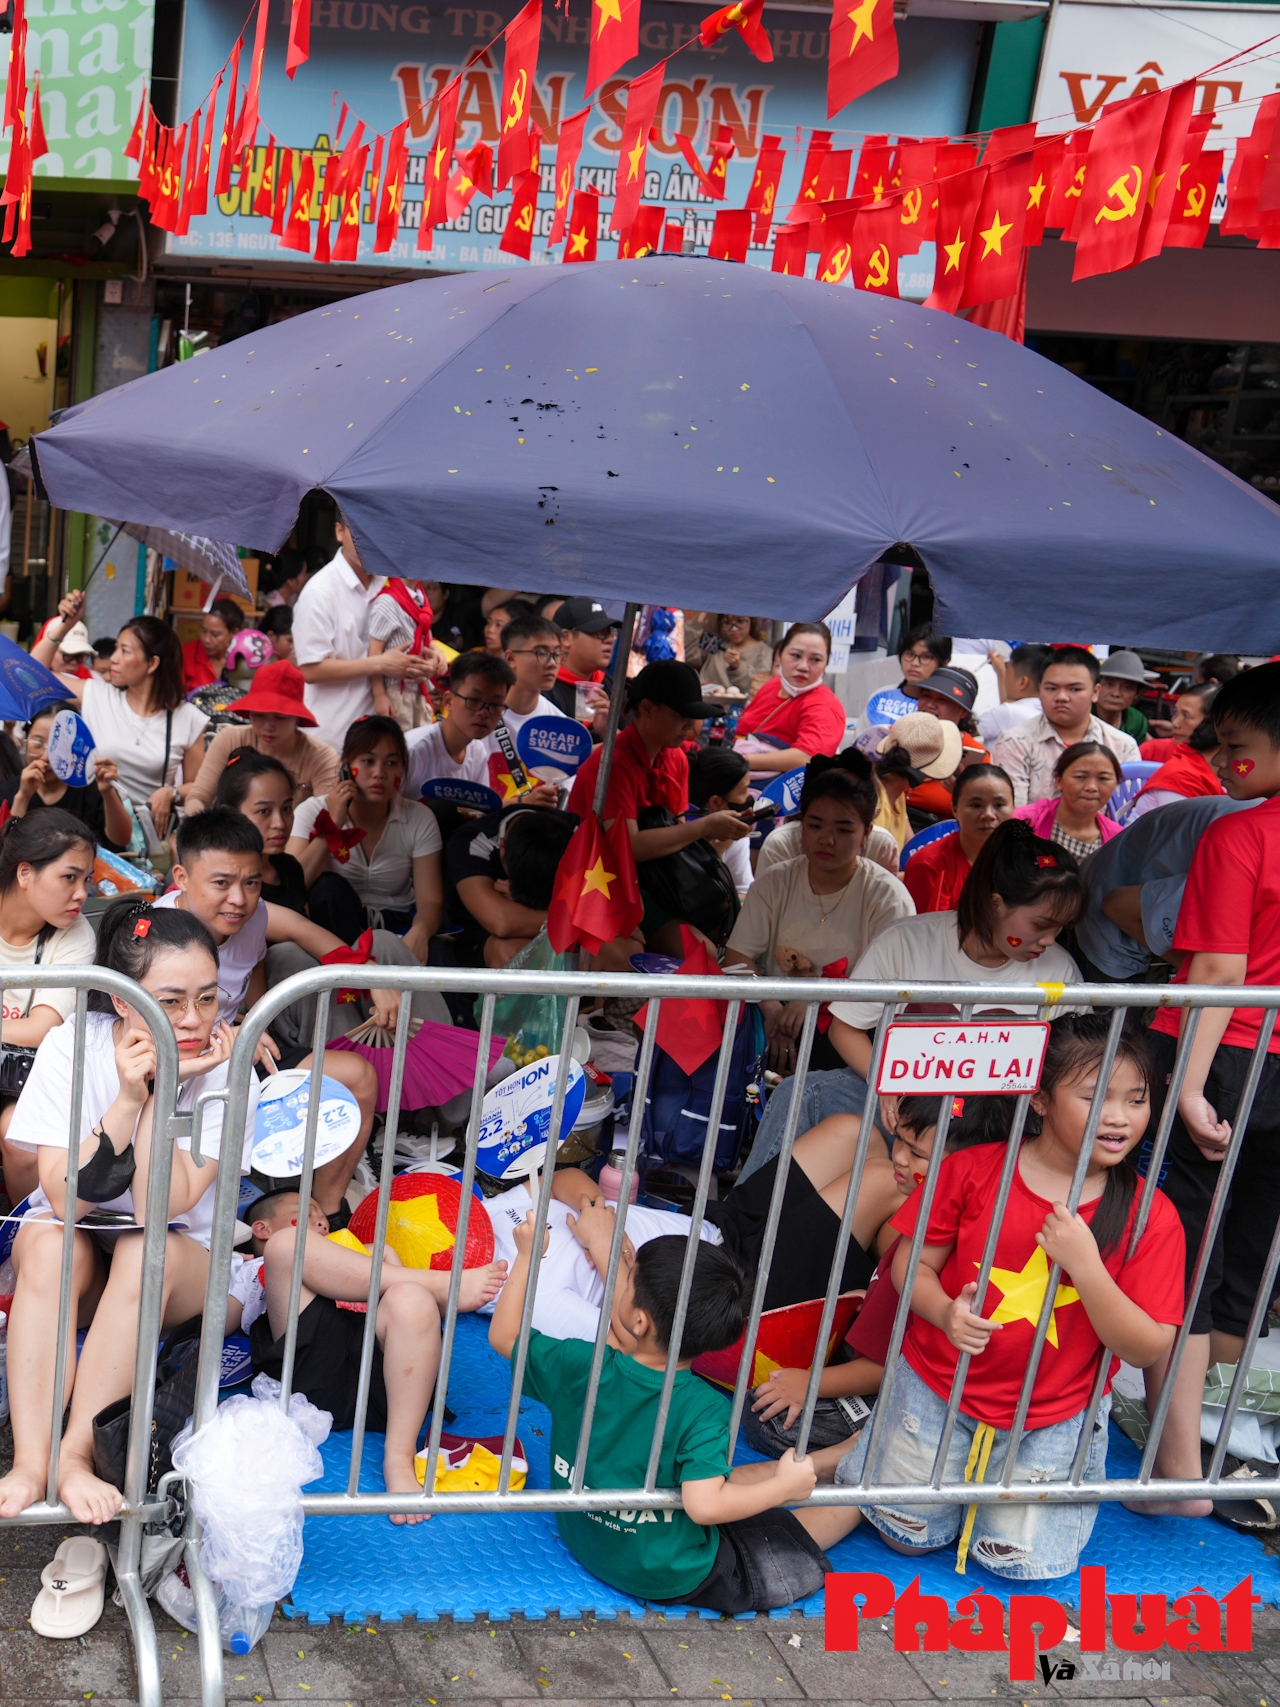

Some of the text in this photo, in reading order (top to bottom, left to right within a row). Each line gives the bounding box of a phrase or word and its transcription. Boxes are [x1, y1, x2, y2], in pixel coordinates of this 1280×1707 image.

[444, 8, 588, 44] TRNH
[528, 727, 581, 746] POCARI
[528, 737, 576, 753] SWEAT
[933, 1031, 1011, 1045] C.A.H.N
[521, 1062, 550, 1090] ION
[889, 1052, 1034, 1083] DỪNG LẠI
[479, 1118, 504, 1142] 2.2
